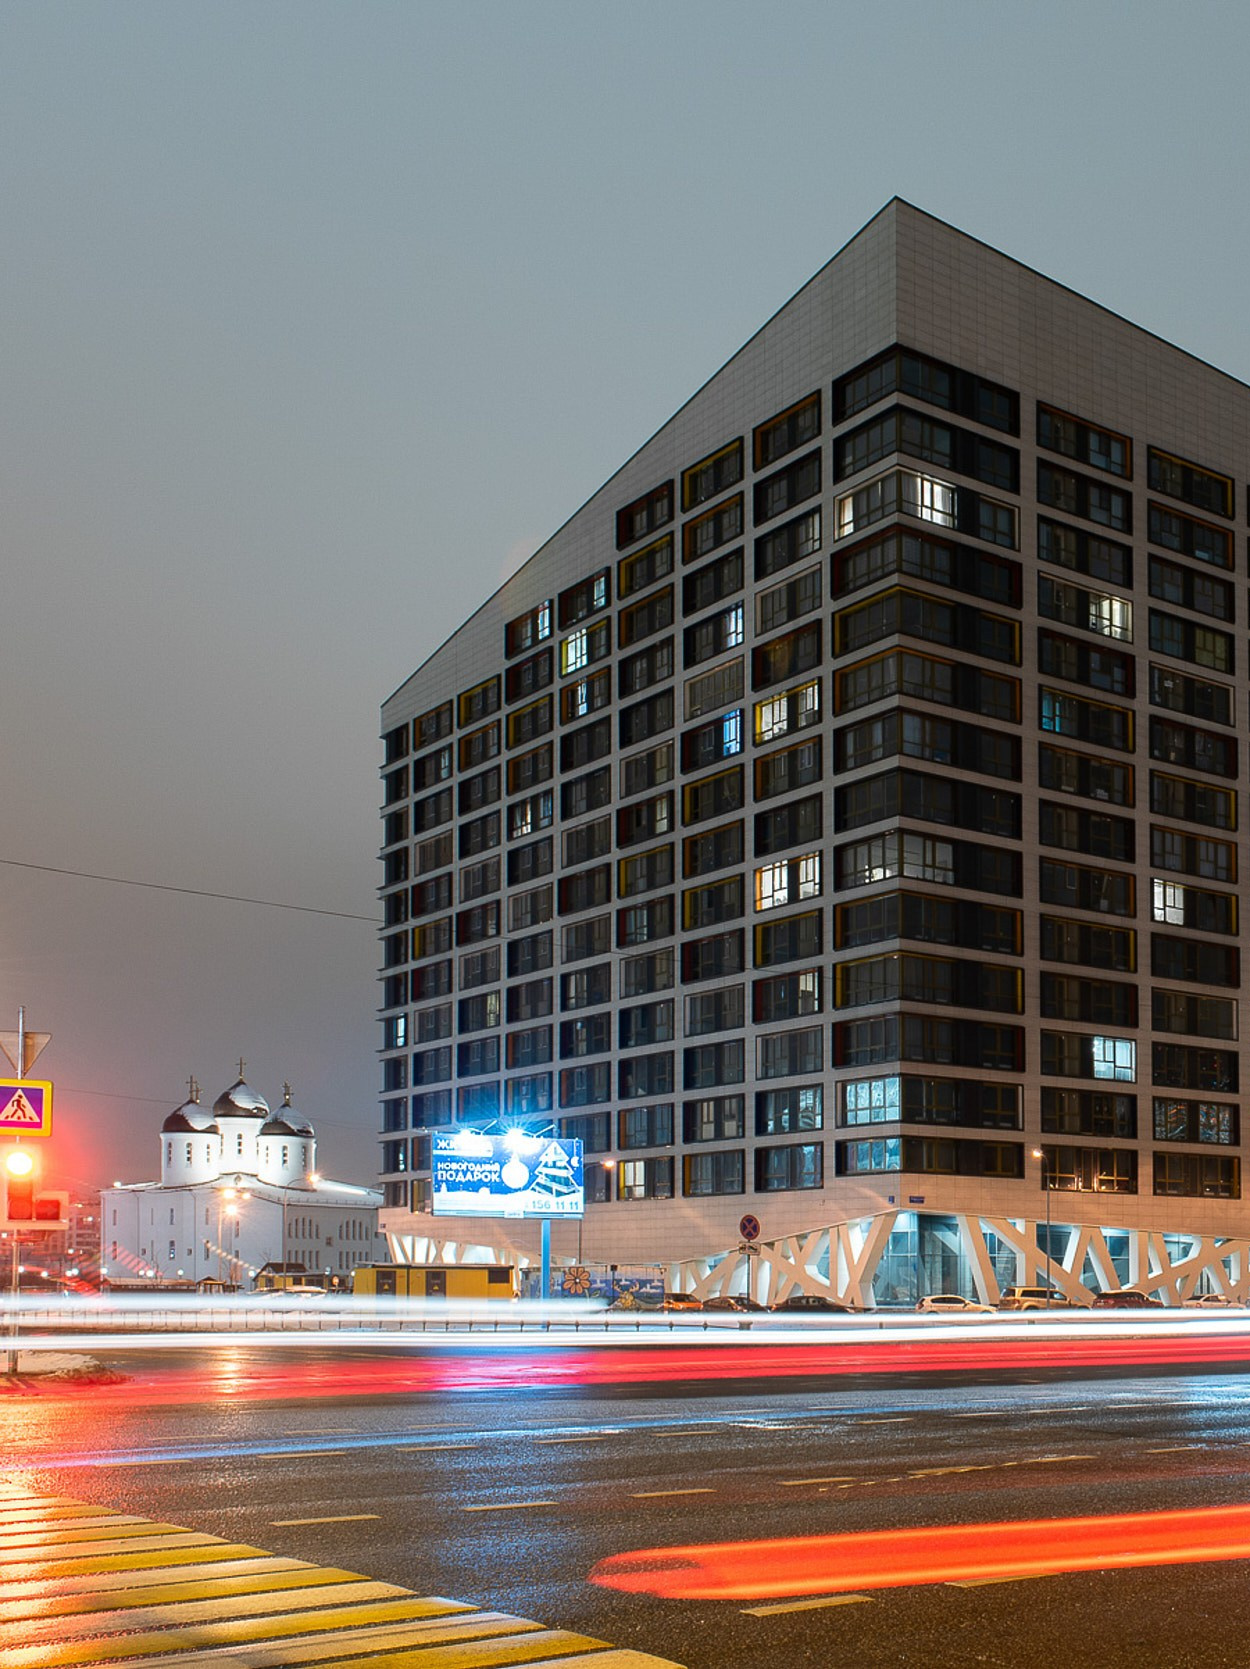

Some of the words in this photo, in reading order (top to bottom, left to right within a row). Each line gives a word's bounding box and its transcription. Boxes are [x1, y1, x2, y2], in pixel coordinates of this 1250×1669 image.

[437, 1161, 500, 1172] НОВОГОДНИЙ
[437, 1170, 500, 1182] ПОДАРОК
[555, 1200, 565, 1210] 11
[569, 1201, 579, 1210] 11
